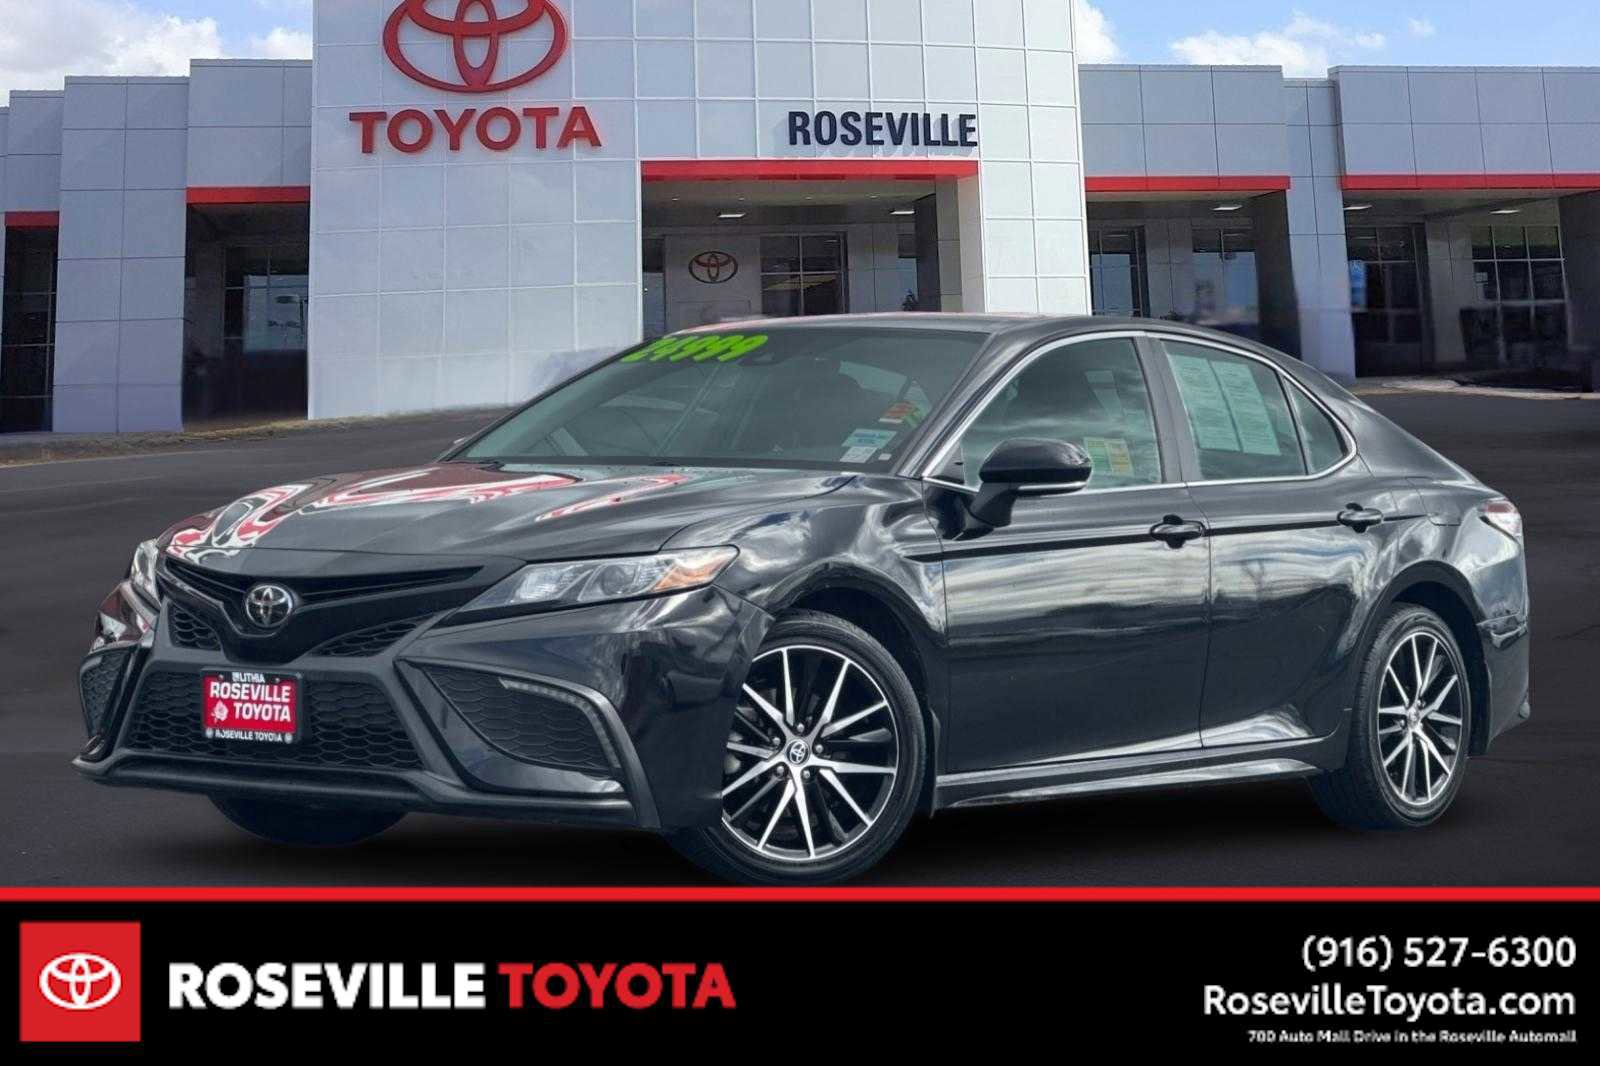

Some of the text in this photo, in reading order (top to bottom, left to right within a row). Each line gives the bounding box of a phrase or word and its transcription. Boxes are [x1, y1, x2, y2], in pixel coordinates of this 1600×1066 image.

[350, 106, 602, 153] TOYOTA
[789, 110, 978, 147] ROSEVILLE
[239, 672, 266, 684] LITHIA
[209, 681, 292, 703] ROSEVILLE
[233, 701, 292, 722] TOYOTA
[215, 728, 283, 742] ROSEVILLE TOYOTA
